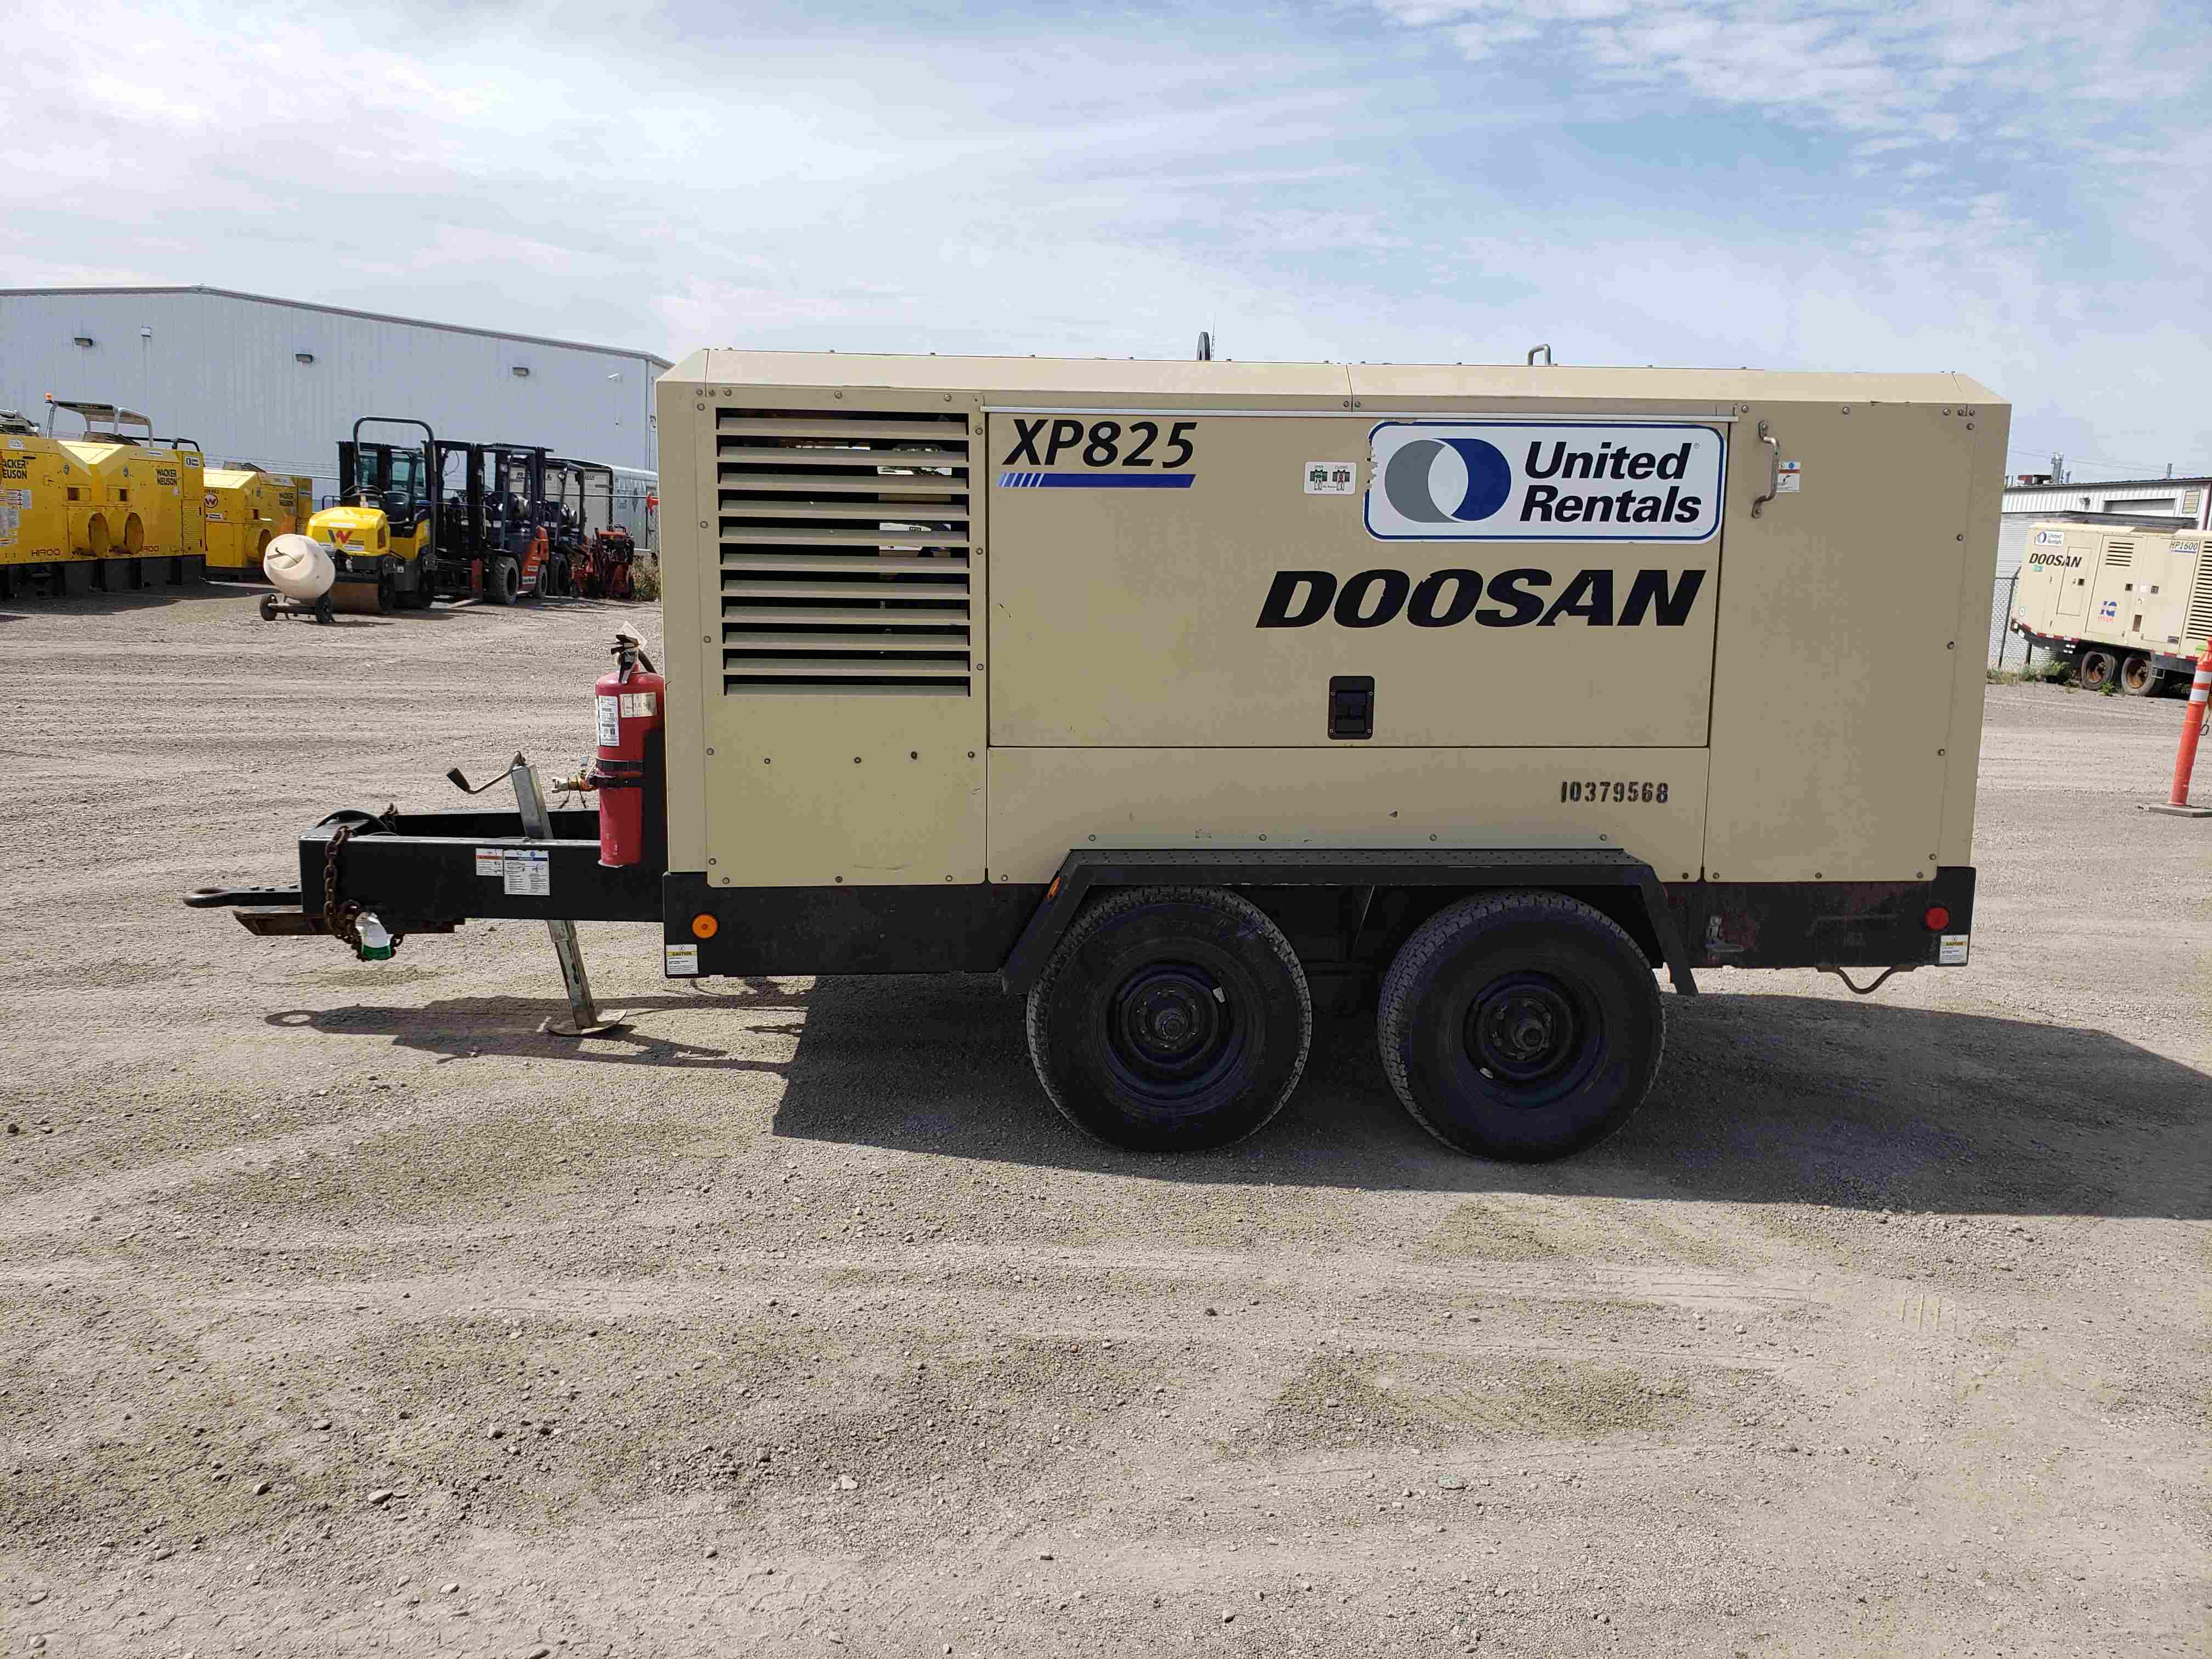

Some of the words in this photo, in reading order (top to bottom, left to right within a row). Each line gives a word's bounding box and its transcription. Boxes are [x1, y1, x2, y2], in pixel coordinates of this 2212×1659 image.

[1002, 419, 1198, 469] XP825
[3, 459, 27, 469] ACKER
[1525, 441, 1692, 480] United
[3, 470, 27, 479] EUSON
[1519, 485, 1702, 523] Rentals
[2169, 541, 2198, 550] HP1600
[2029, 553, 2082, 567] DOOSAN
[1256, 569, 1707, 628] DOOSAN
[1561, 781, 1668, 803] 10379568
